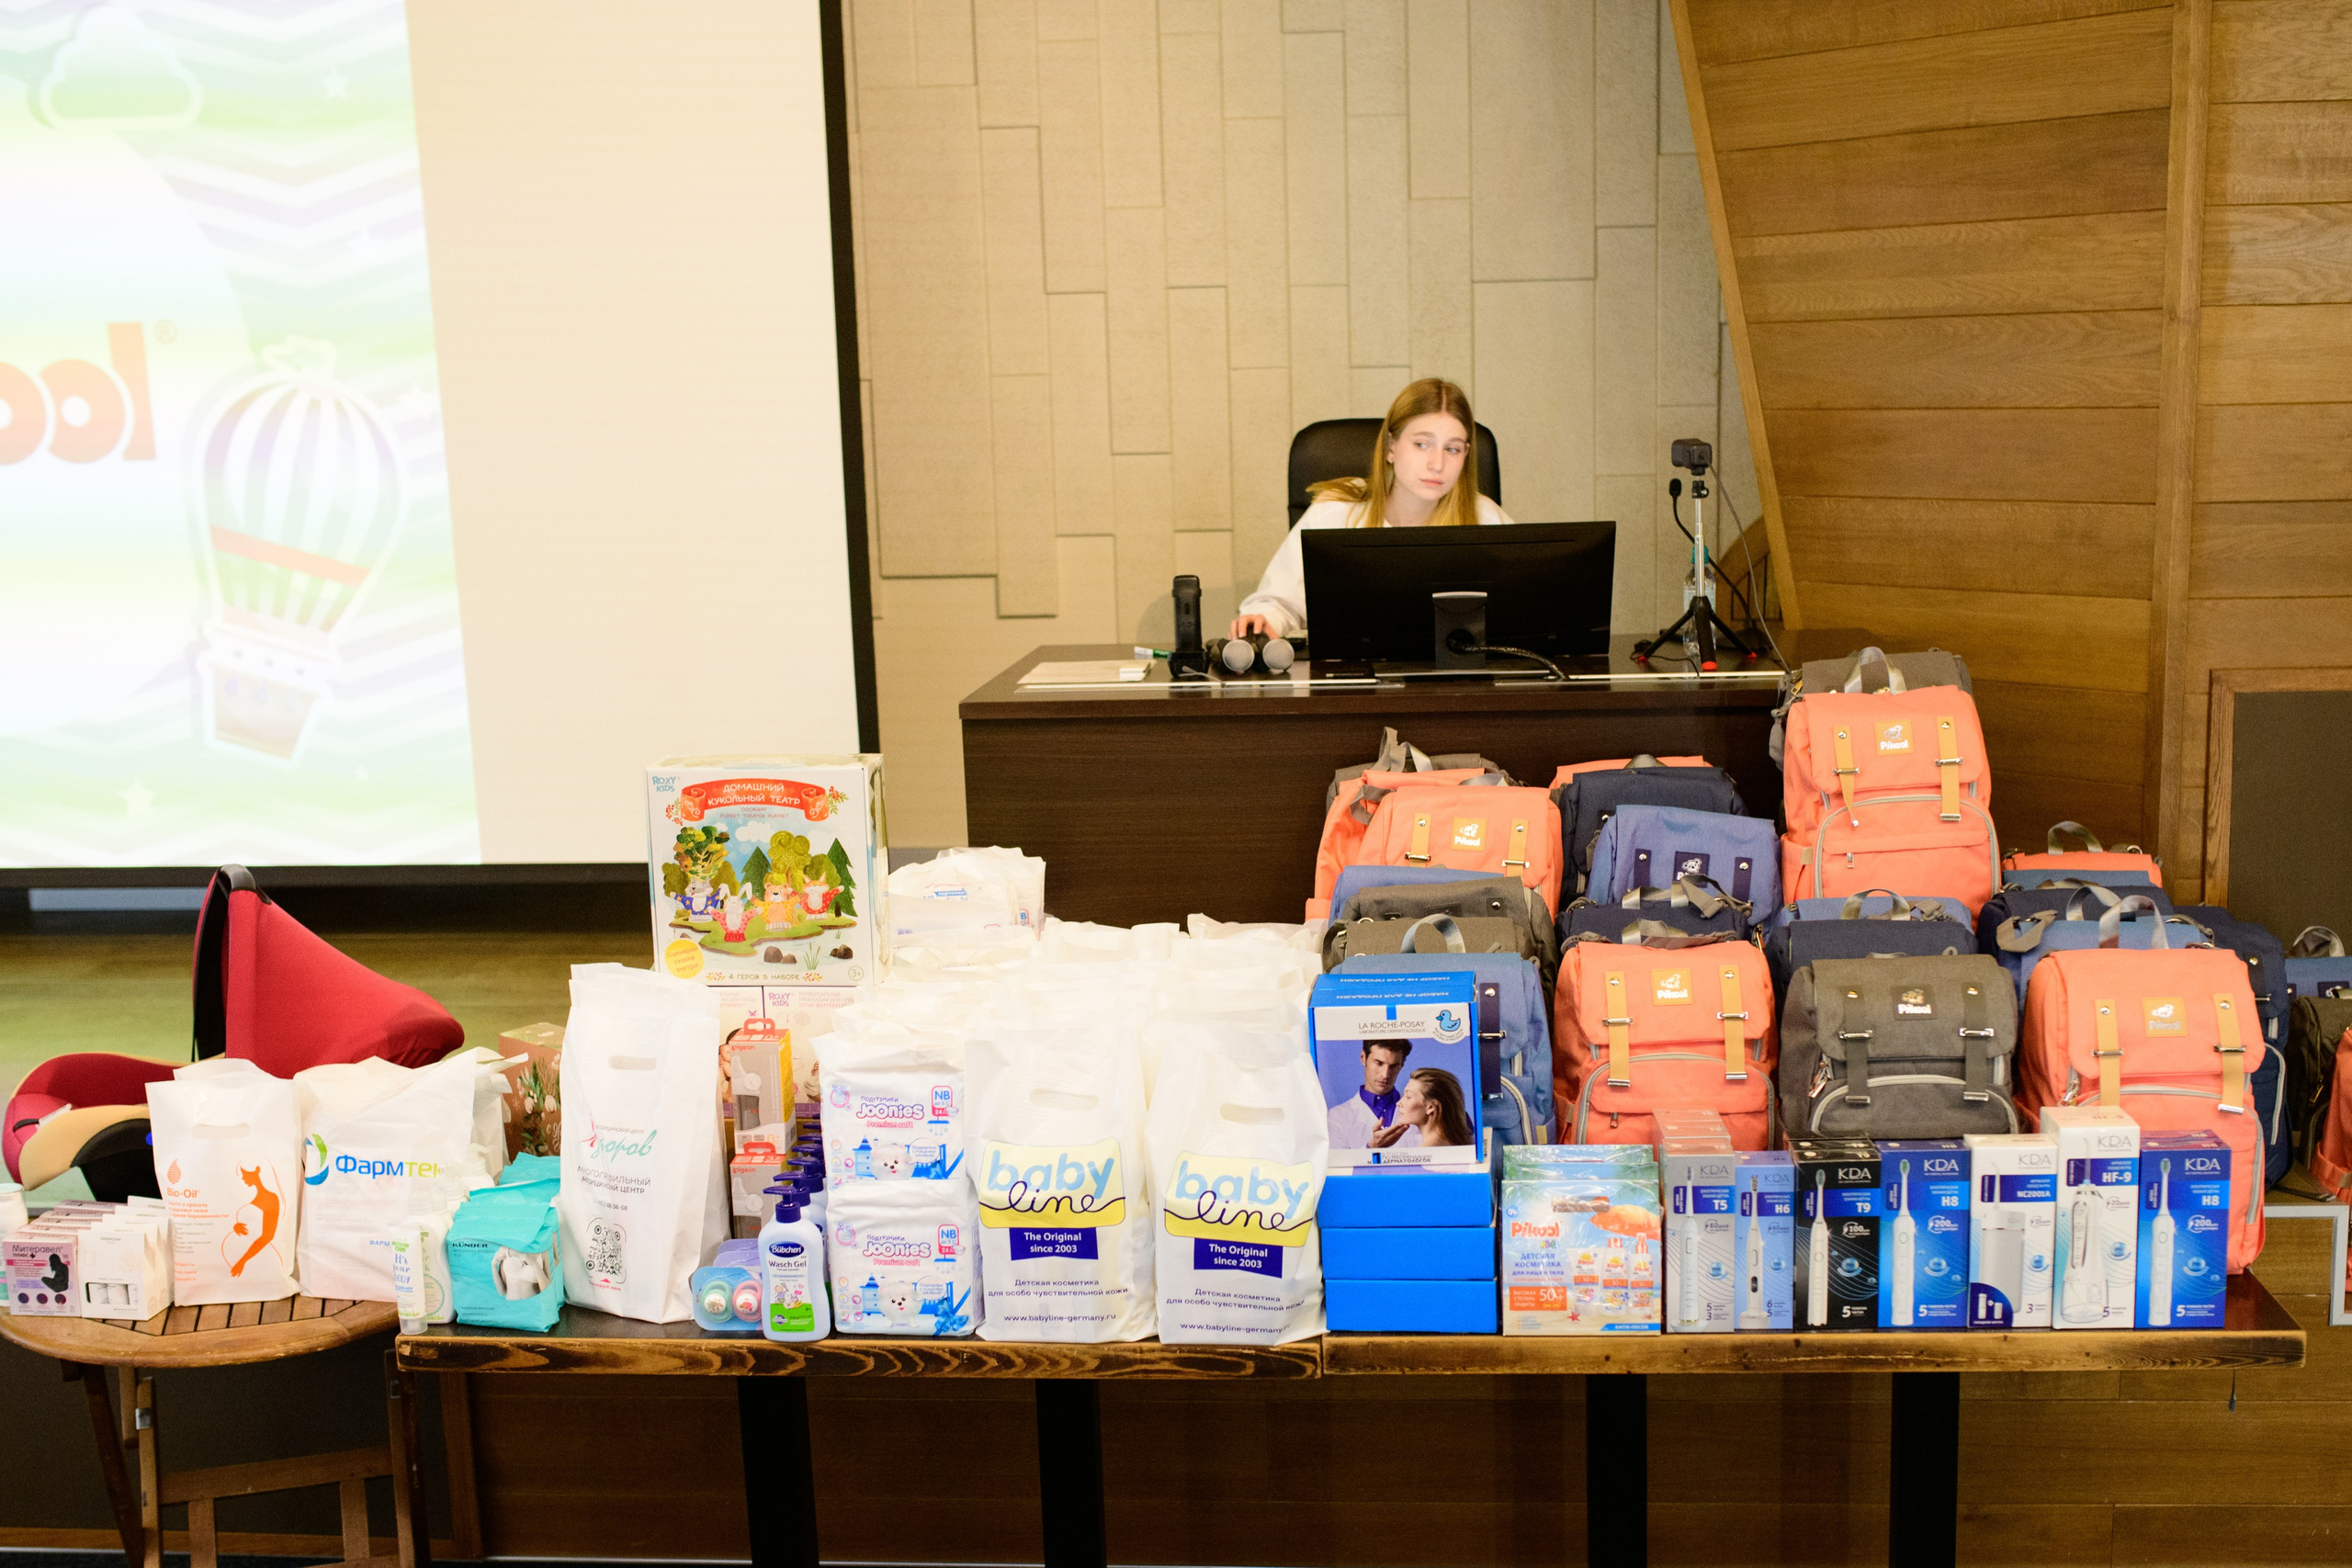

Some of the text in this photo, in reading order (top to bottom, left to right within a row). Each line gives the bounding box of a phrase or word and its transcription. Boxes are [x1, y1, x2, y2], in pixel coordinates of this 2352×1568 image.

[1880, 739, 1908, 750] Pikool
[652, 775, 676, 786] ROXY
[656, 784, 675, 793] KIDS
[723, 783, 784, 793] ДОМАШНИЙ
[707, 793, 800, 807] КУКОЛЬНЫЙ ТЕАТР
[1454, 836, 1480, 847] Pikool
[667, 947, 698, 957] Сценарии
[674, 956, 695, 964] сказок
[851, 969, 862, 977] 3+
[769, 992, 790, 1000] ROXY
[1657, 988, 1688, 999] Pikool
[934, 1090, 951, 1100] NB
[866, 1120, 914, 1129] Premium soft
[2097, 1135, 2132, 1148] KDA
[1924, 1159, 1960, 1172] KDA
[2018, 1154, 2052, 1166] KDA
[2185, 1157, 2222, 1170] KDA
[987, 1149, 1114, 1200] baby
[1700, 1165, 1729, 1176] KDA
[1838, 1168, 1872, 1179] KDA
[1764, 1174, 1791, 1183] KDA
[2102, 1172, 2132, 1183] HF-9
[167, 1188, 198, 1199] Bio-Oil
[1175, 1160, 1309, 1220] baby
[979, 1180, 1125, 1213] line
[1941, 1196, 1959, 1207] H8
[2201, 1195, 2220, 1205] H8
[1164, 1190, 1313, 1232] line
[1713, 1200, 1727, 1211] T5
[1775, 1203, 1791, 1214] H6
[1856, 1202, 1871, 1213] T9
[941, 1229, 956, 1239] NB
[1023, 1232, 1082, 1243] The Original
[12, 1245, 61, 1254] Митеравел
[771, 1245, 801, 1253] Bübchen
[1030, 1245, 1078, 1253] since 2003
[1209, 1244, 1268, 1258] The Original
[395, 1253, 408, 1265] It's
[768, 1259, 792, 1268] Wasch
[873, 1258, 921, 1267] Premium soft
[1214, 1257, 1262, 1268] since 2003
[1194, 1288, 1281, 1303] Детская косметика
[1213, 1301, 1284, 1312] чувствительной
[1706, 1303, 1713, 1312] 5
[1766, 1299, 1773, 1308] 6
[2027, 1303, 2034, 1314] 3
[1767, 1308, 1773, 1317] 5
[1841, 1306, 1851, 1317] 5
[1918, 1304, 1928, 1317] 5
[2102, 1306, 2109, 1317] 5
[2176, 1304, 2185, 1317] 5
[1003, 1314, 1116, 1323] www.babyline-germany.ru
[1706, 1312, 1713, 1321] 3
